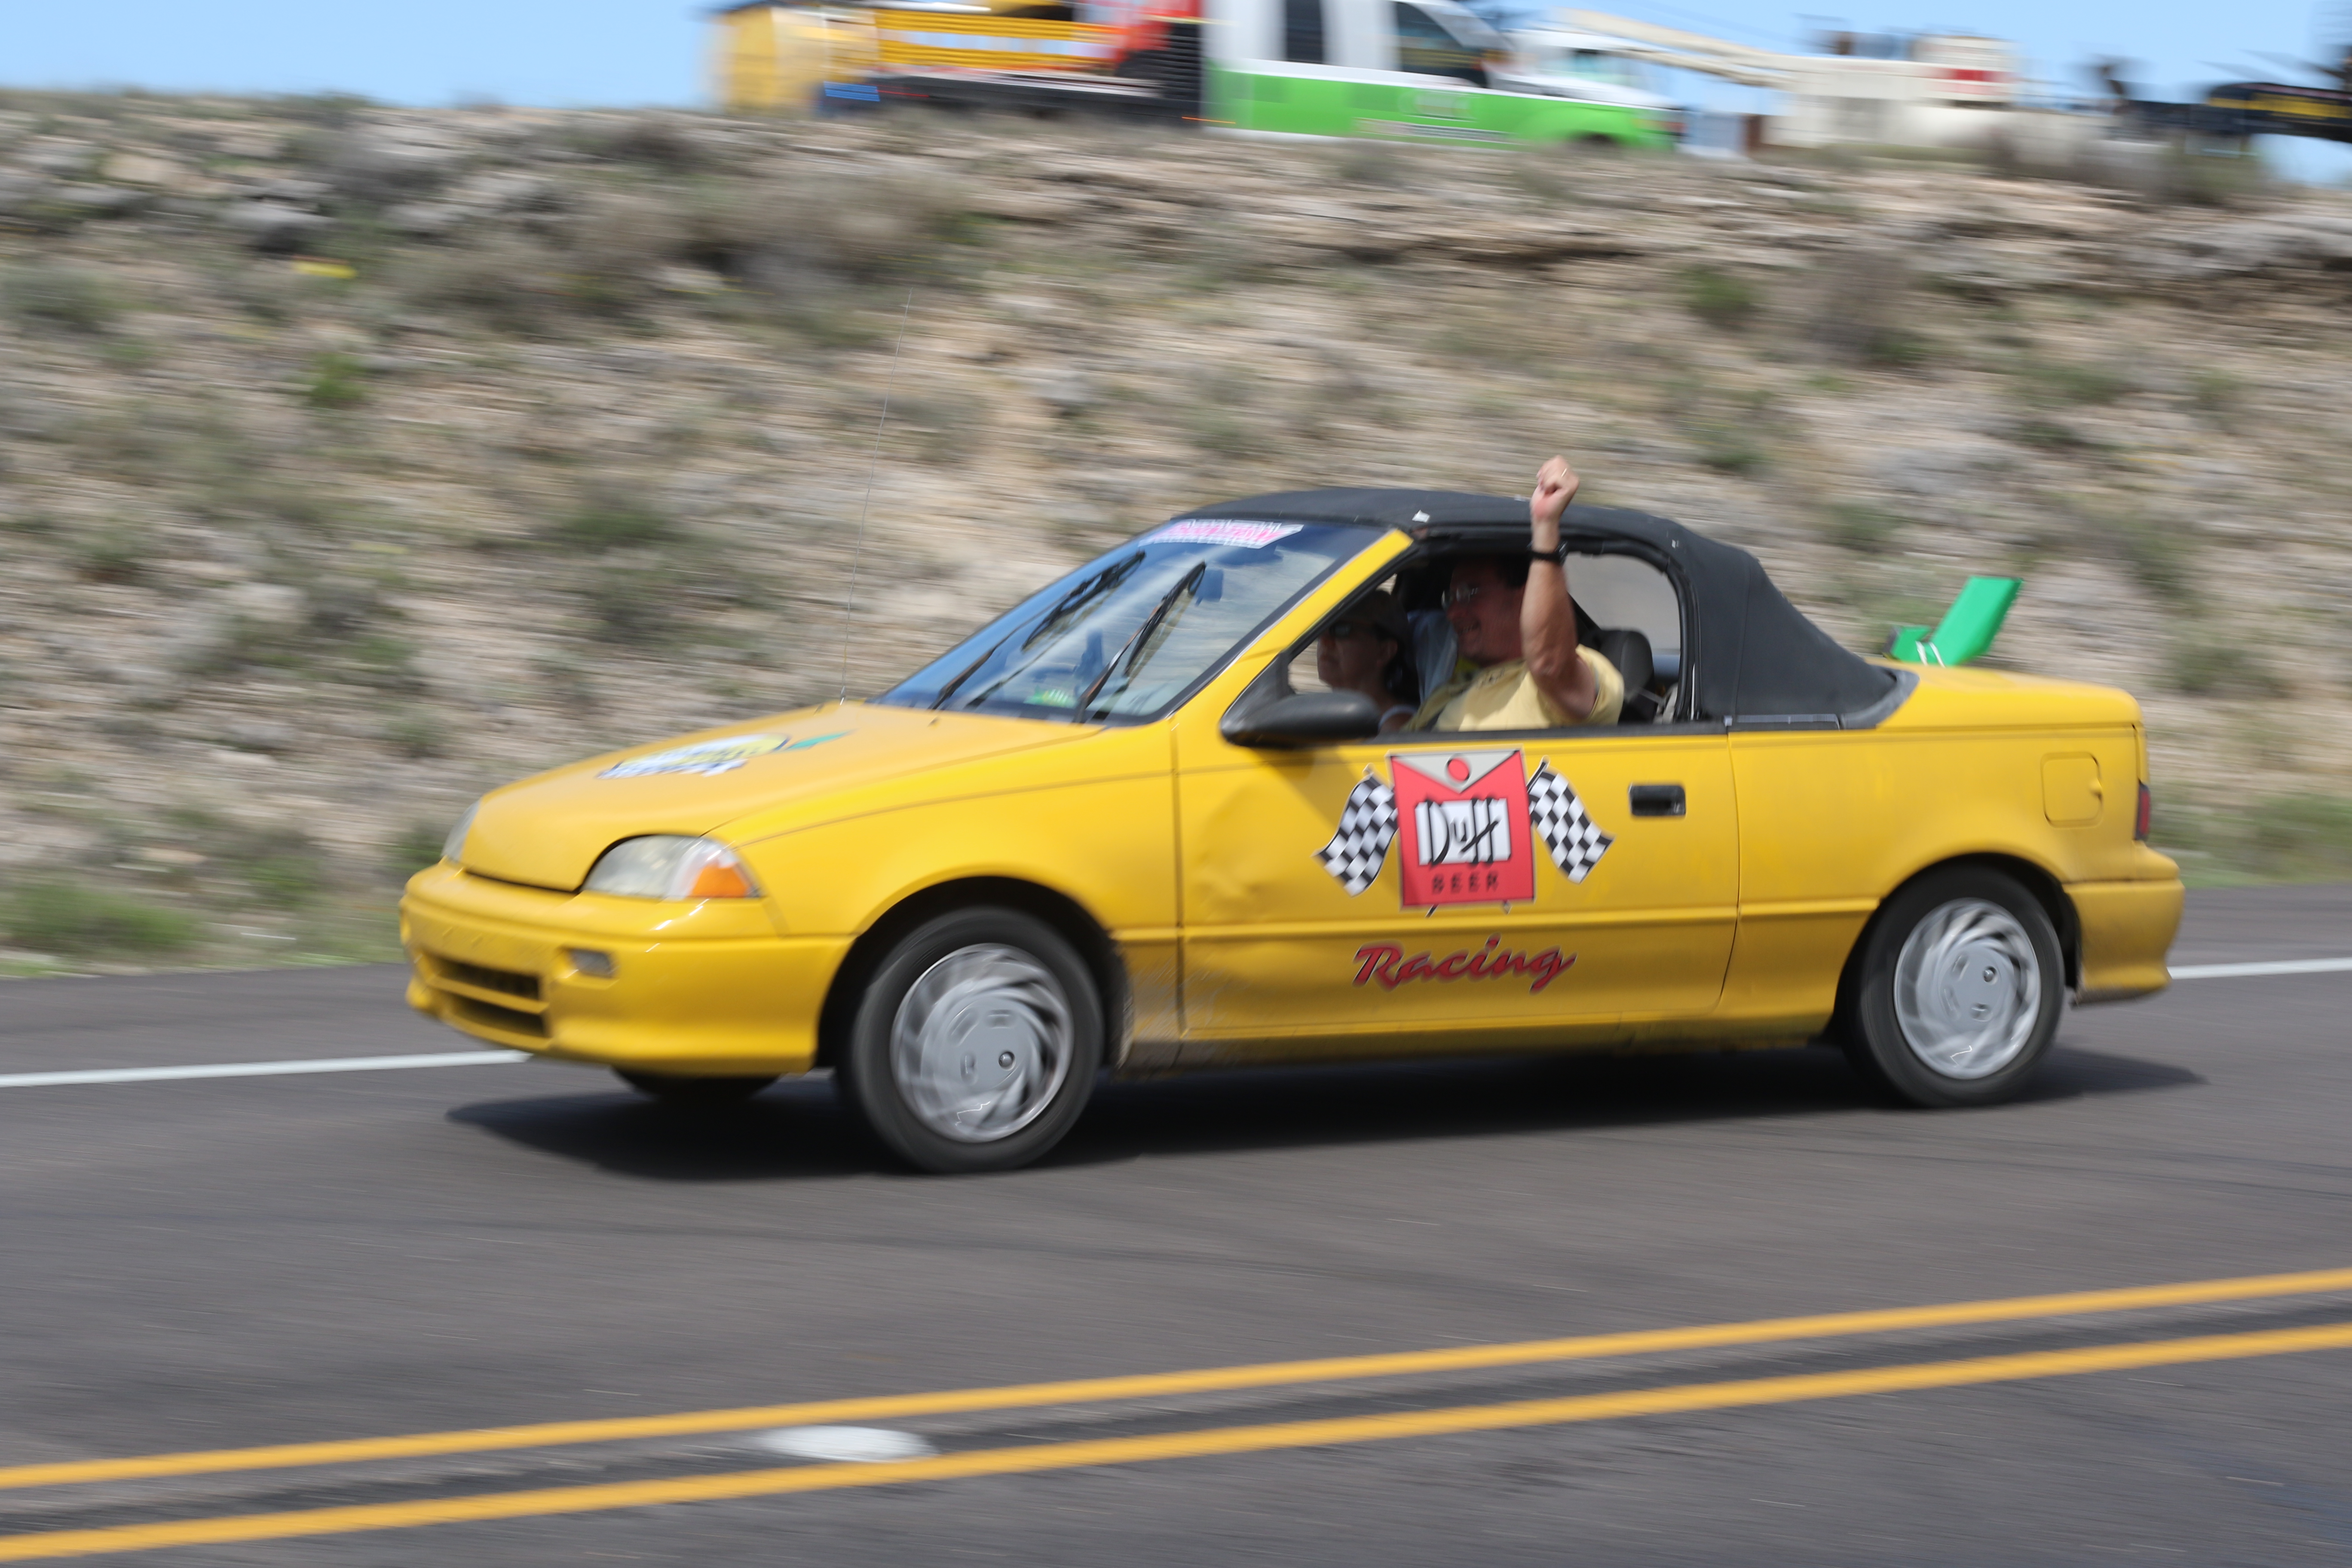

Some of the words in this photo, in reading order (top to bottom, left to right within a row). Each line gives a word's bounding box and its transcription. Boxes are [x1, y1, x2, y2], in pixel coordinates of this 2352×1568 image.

[1424, 796, 1499, 866] Duff
[1432, 872, 1498, 894] BEER
[1353, 934, 1577, 994] Racing
